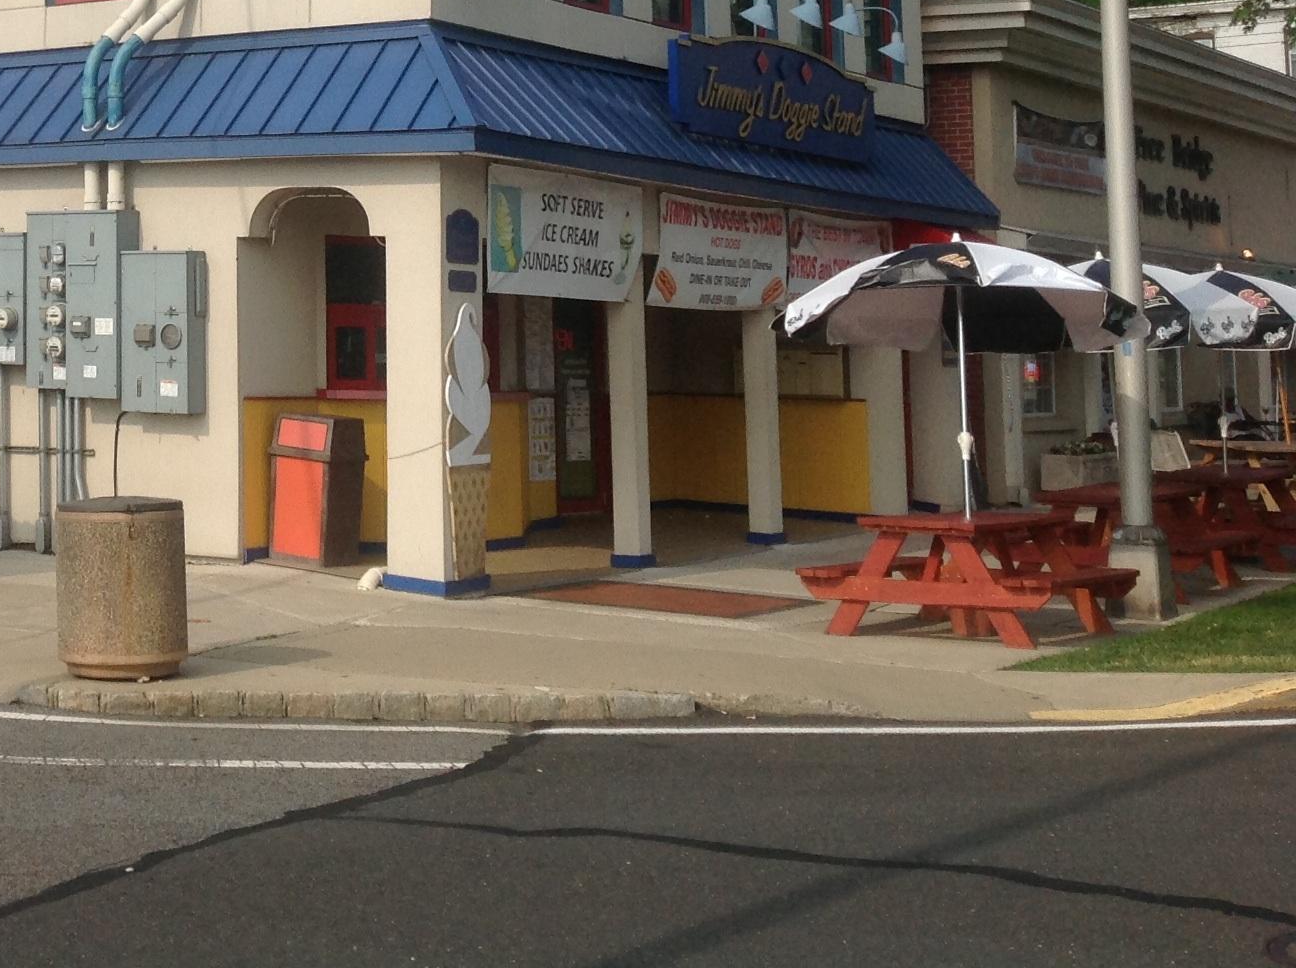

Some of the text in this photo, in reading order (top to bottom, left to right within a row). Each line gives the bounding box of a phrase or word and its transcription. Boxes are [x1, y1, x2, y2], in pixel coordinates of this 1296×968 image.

[697, 66, 868, 141] Jimmy's Doggie Stand
[541, 193, 604, 220] SOFT SERVE
[542, 223, 600, 248] ICE CREAM
[522, 251, 615, 279] SUNDAES SHAKES
